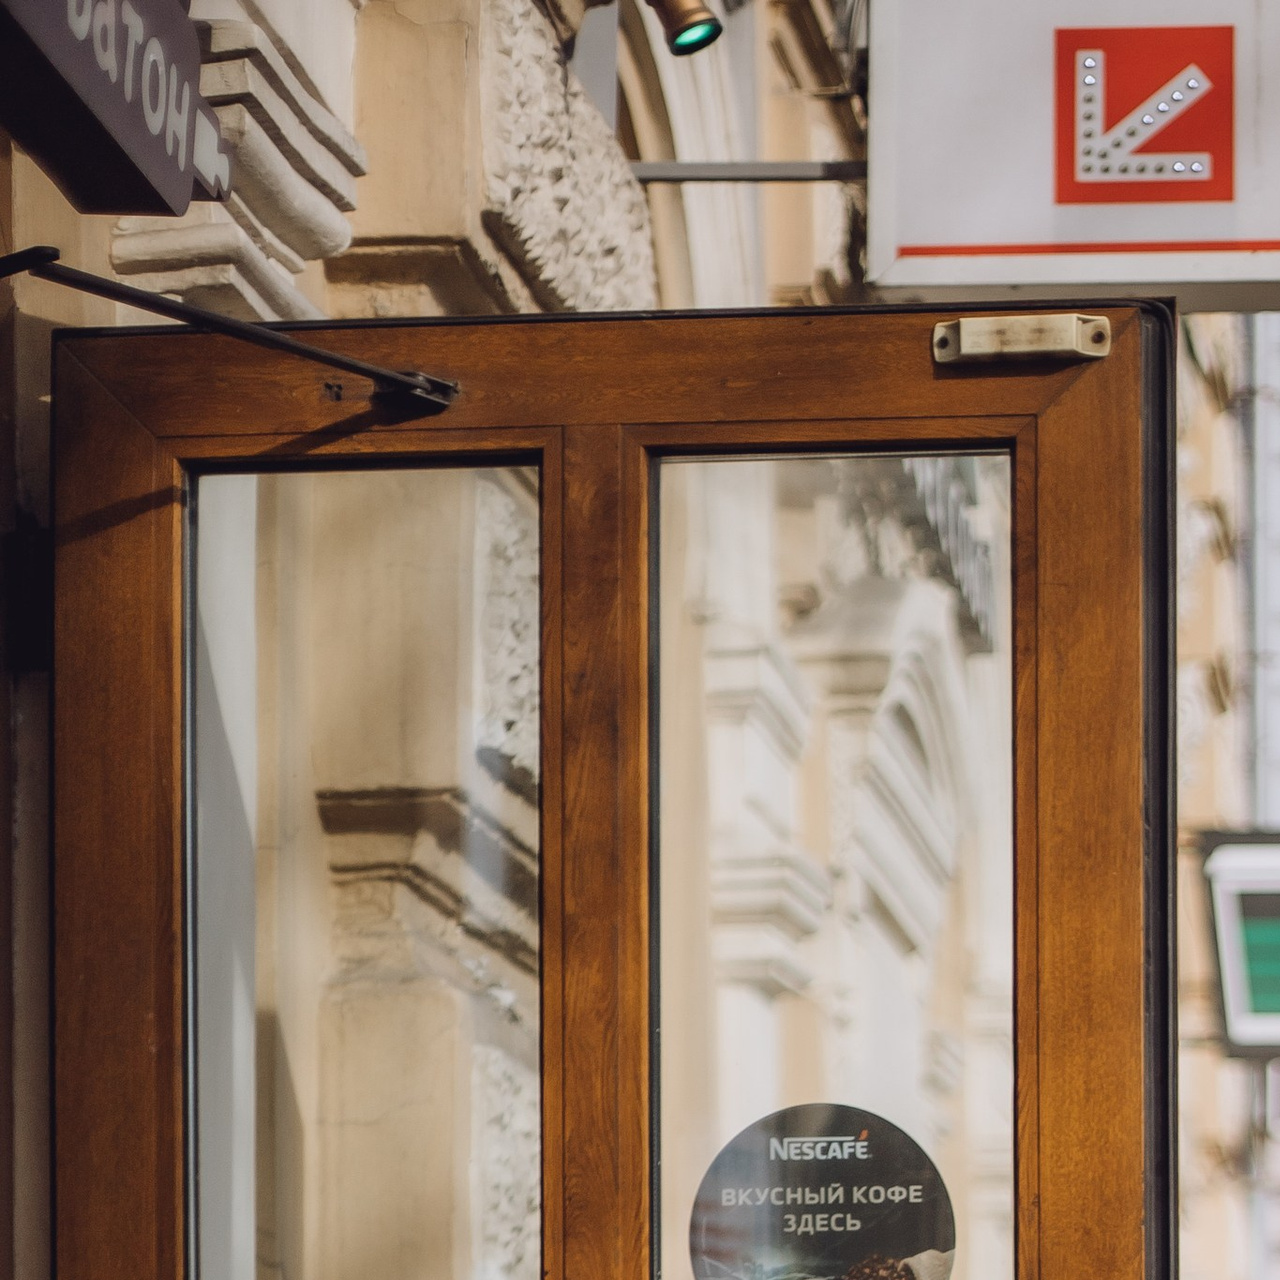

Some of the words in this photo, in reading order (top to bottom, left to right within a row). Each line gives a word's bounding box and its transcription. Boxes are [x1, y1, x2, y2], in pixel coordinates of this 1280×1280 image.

[769, 1129, 869, 1161] NESCAFÉ
[721, 1183, 845, 1207] ВКУСНЫЙ
[852, 1185, 923, 1204] КОФЕ
[783, 1213, 862, 1235] ЗДЕСЬ
